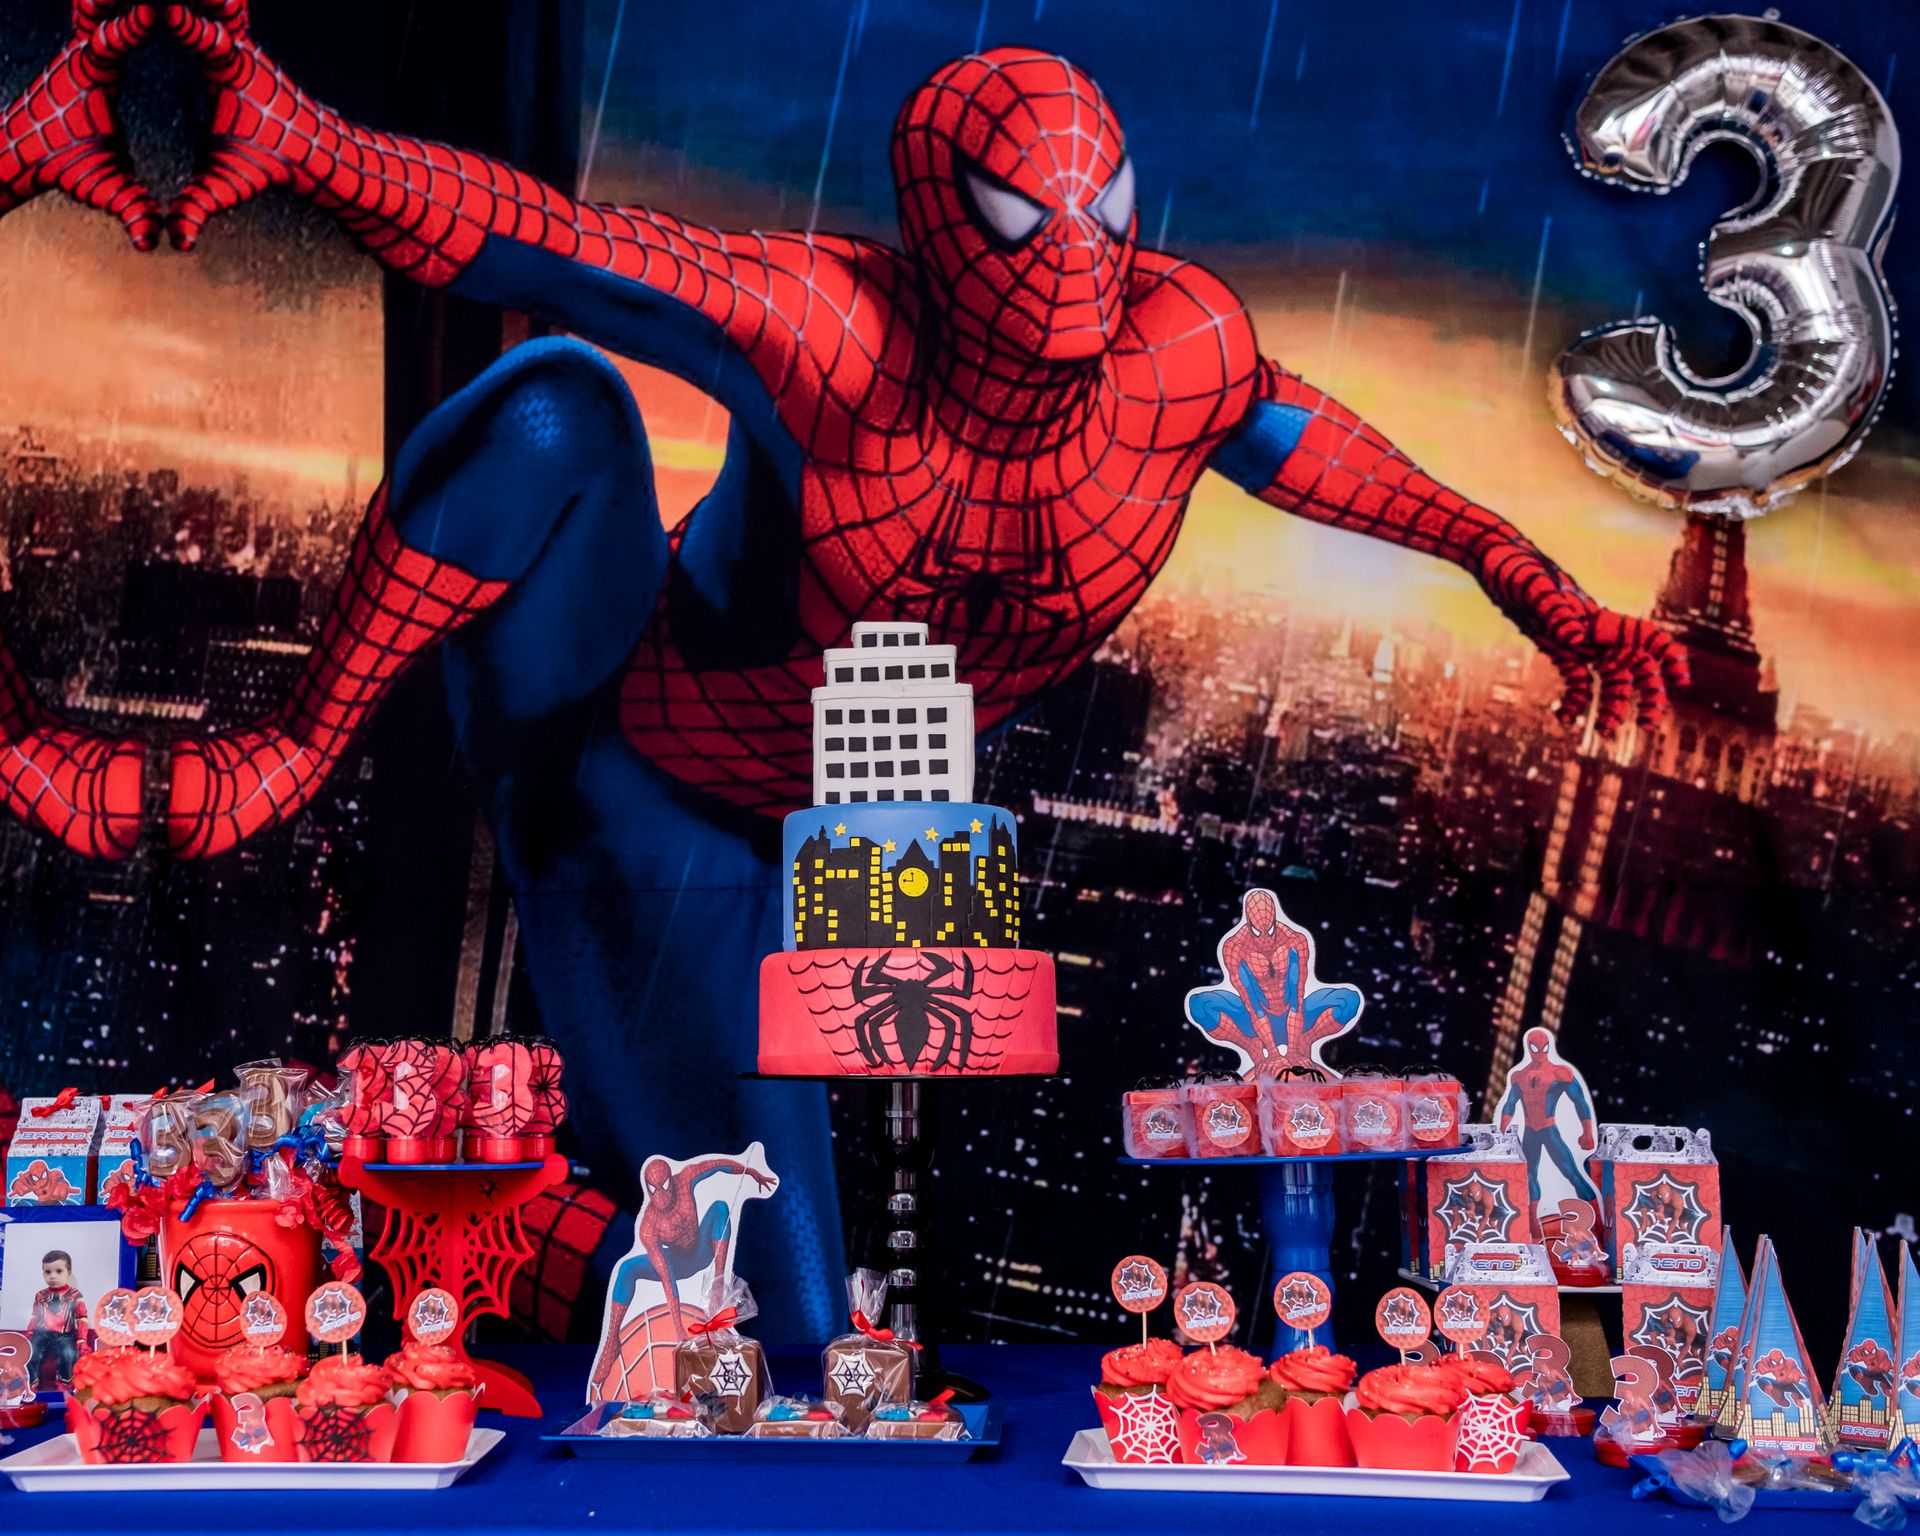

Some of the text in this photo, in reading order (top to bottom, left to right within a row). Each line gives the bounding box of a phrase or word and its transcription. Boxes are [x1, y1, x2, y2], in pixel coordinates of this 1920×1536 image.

[1549, 13, 1903, 514] 3
[1472, 1260, 1515, 1272] ENO
[1649, 1258, 1702, 1270] RENO
[1521, 1334, 1582, 1413] 3
[1600, 1355, 1666, 1440] 3
[1841, 1425, 1889, 1438] BREN
[1755, 1440, 1815, 1451] BRENO
